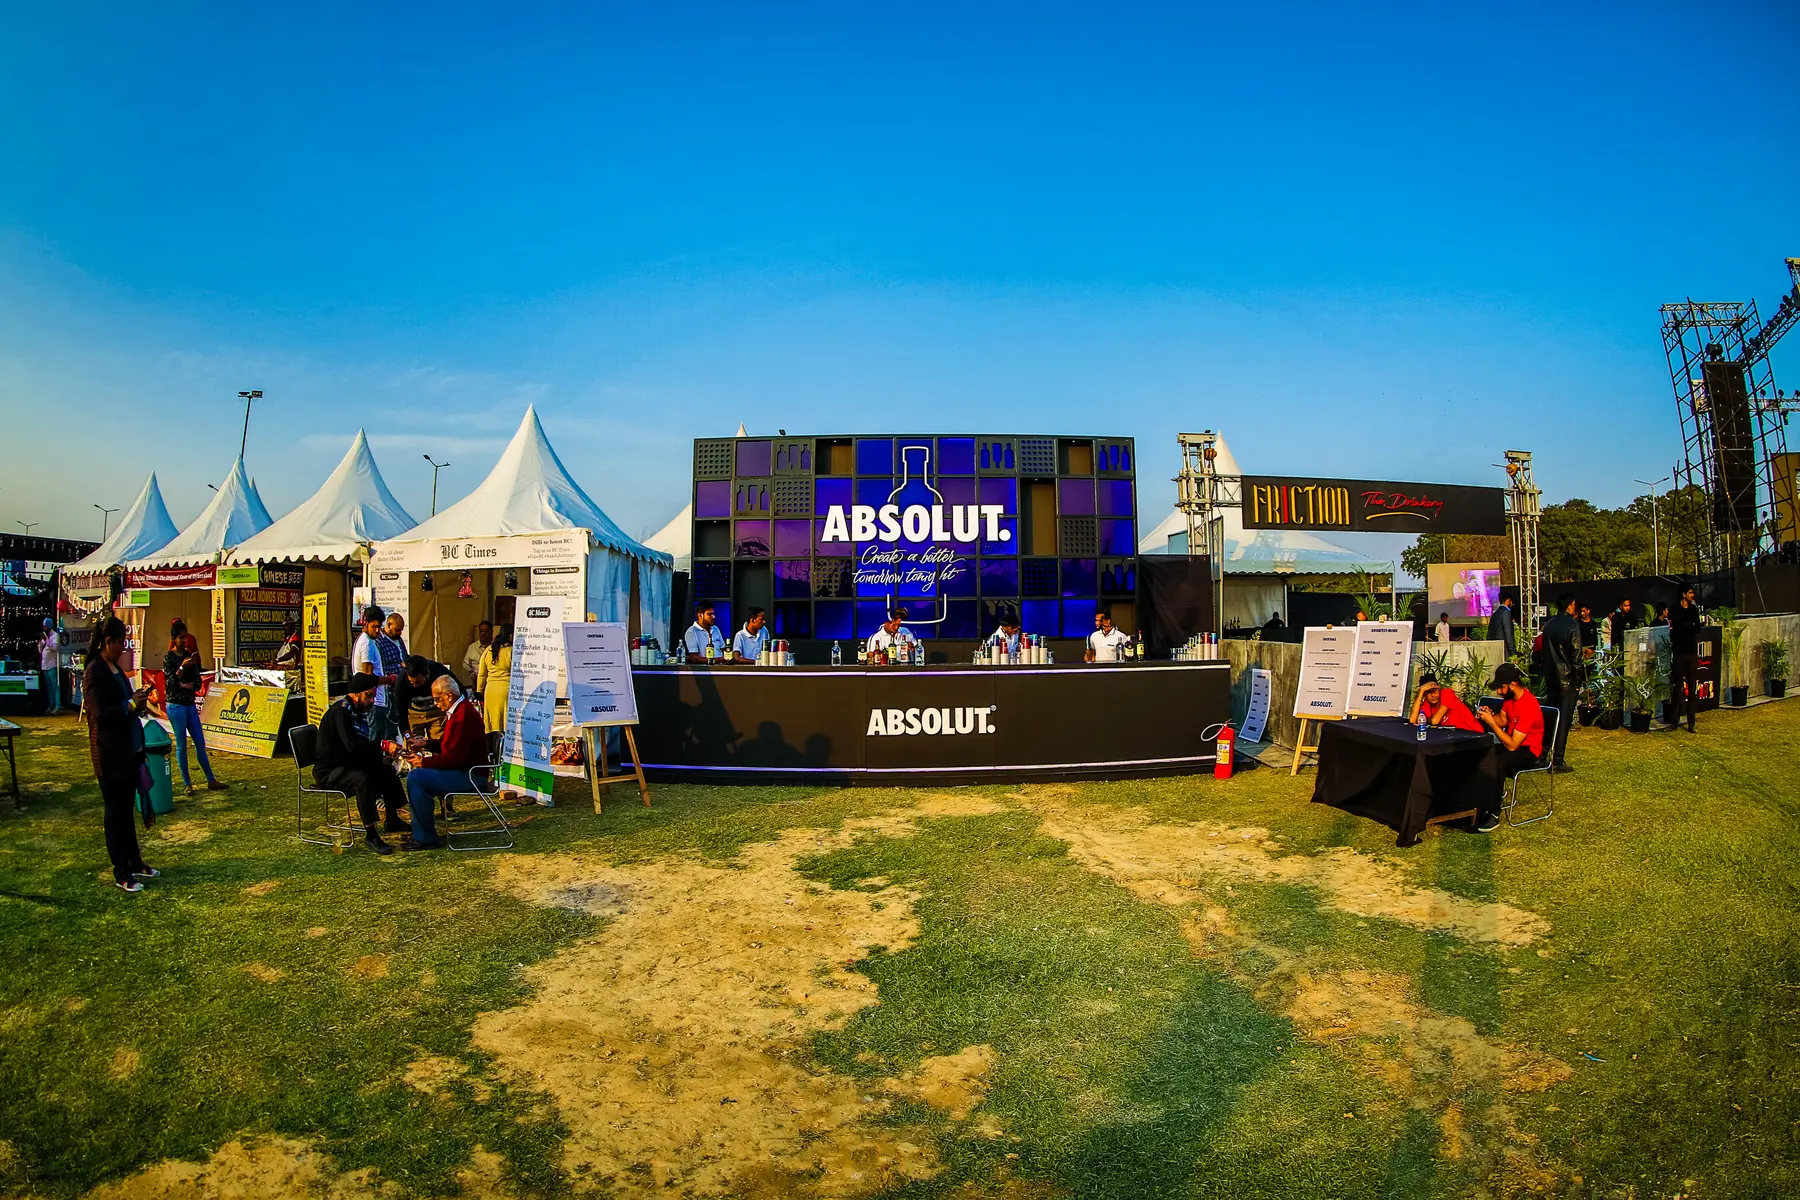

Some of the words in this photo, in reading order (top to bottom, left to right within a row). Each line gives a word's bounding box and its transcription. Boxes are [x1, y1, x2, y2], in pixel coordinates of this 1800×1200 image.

[1252, 484, 1350, 525] FRICTION
[821, 504, 1011, 543] ABSOLUT.
[440, 544, 459, 564] BC
[464, 544, 497, 558] Times
[861, 545, 906, 565] Create
[907, 553, 917, 562] a
[919, 546, 966, 564] better
[240, 589, 256, 602] PIZZA
[257, 589, 276, 603] MOMOS
[277, 590, 287, 603] VEG
[1310, 700, 1333, 708] ABSOLUT.
[1363, 695, 1388, 703] ABSOLUT.
[591, 705, 619, 713] ABSOLUT.
